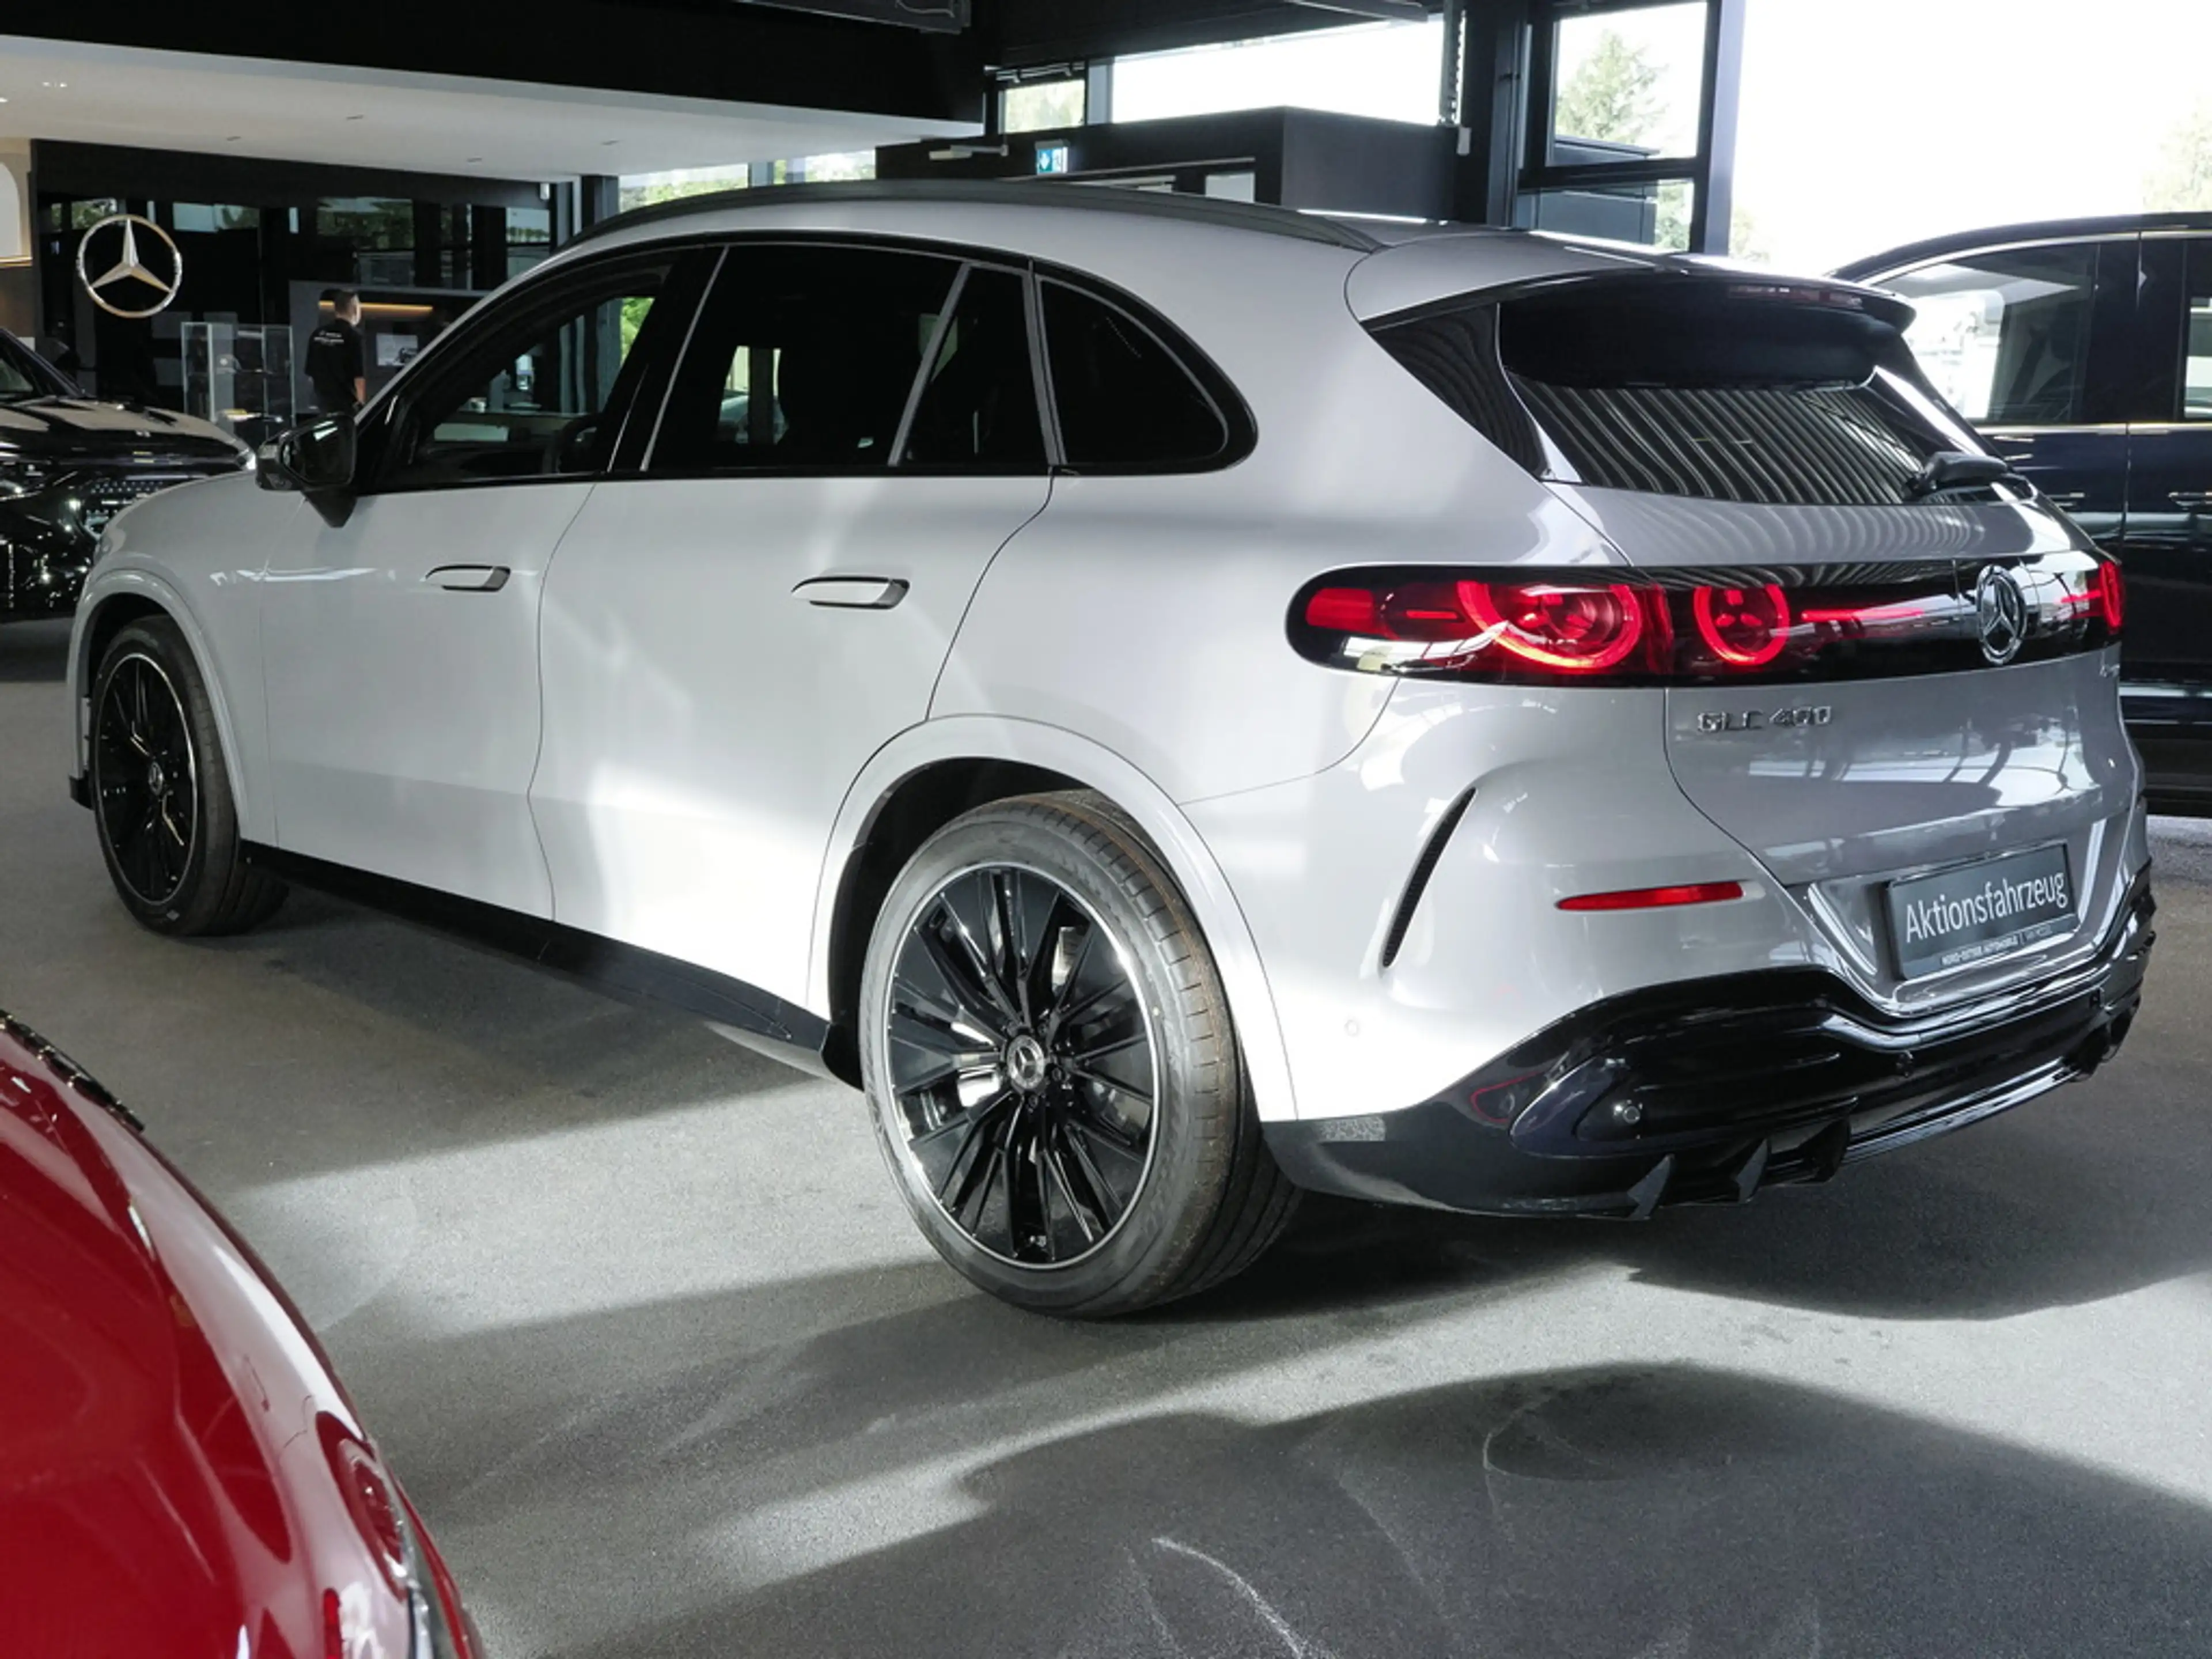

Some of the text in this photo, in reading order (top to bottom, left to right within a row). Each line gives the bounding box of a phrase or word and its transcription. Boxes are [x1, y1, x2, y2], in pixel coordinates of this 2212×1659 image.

[1698, 705, 1831, 733] GLC 400
[1906, 872, 2069, 944] Aktionsfahrzeug
